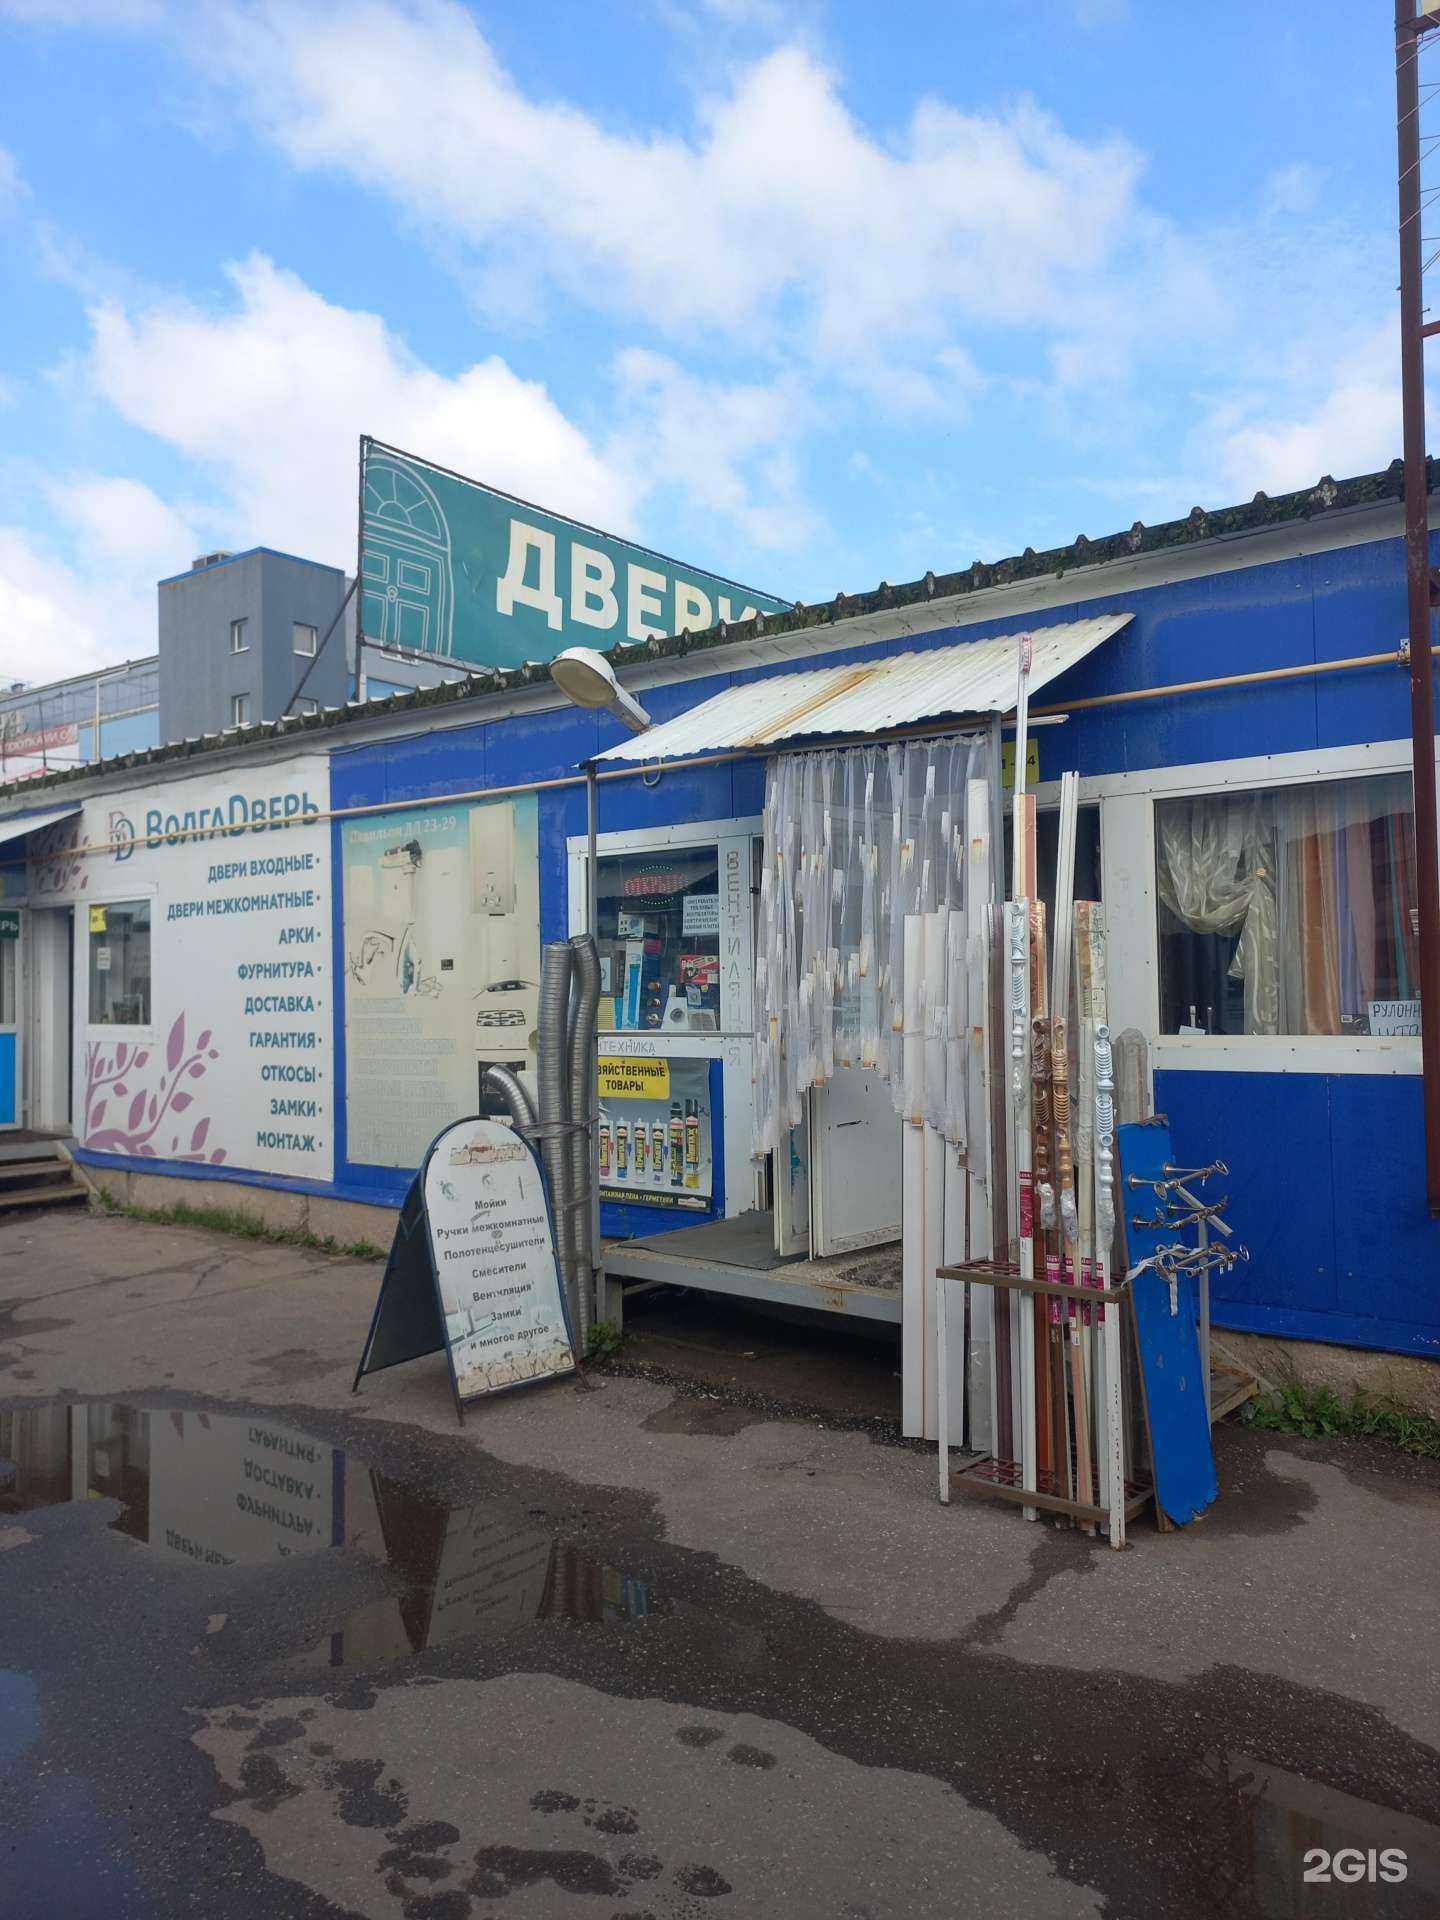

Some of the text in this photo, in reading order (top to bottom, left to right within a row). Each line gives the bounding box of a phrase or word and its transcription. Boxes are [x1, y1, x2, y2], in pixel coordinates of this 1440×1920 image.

[208, 853, 313, 883] ДВЕРИ ВХОДНЫЕ
[167, 890, 313, 921] ДВЕРИ МЕЖКОМНАТНЫЕ
[279, 927, 314, 944] АРКИ
[237, 961, 314, 981] ФУРНИТУРА
[244, 996, 314, 1015] ДОСТАВКА
[249, 1032, 315, 1049] ГАРАНТИЯ
[261, 1065, 316, 1083] ОТКОСЫ
[605, 1080, 644, 1091] ТОВАРЫ
[270, 1098, 316, 1117] ЗАМКИ
[257, 1131, 316, 1152] МОНТАЖ
[475, 1198, 507, 1210] Мойки
[436, 1215, 544, 1240] Ручки межкомнатные
[444, 1236, 545, 1260] Полотенцесушители
[472, 1262, 527, 1278] Смесители
[491, 1308, 522, 1322] Замки
[479, 1333, 515, 1348] многое
[517, 1325, 549, 1342] другое
